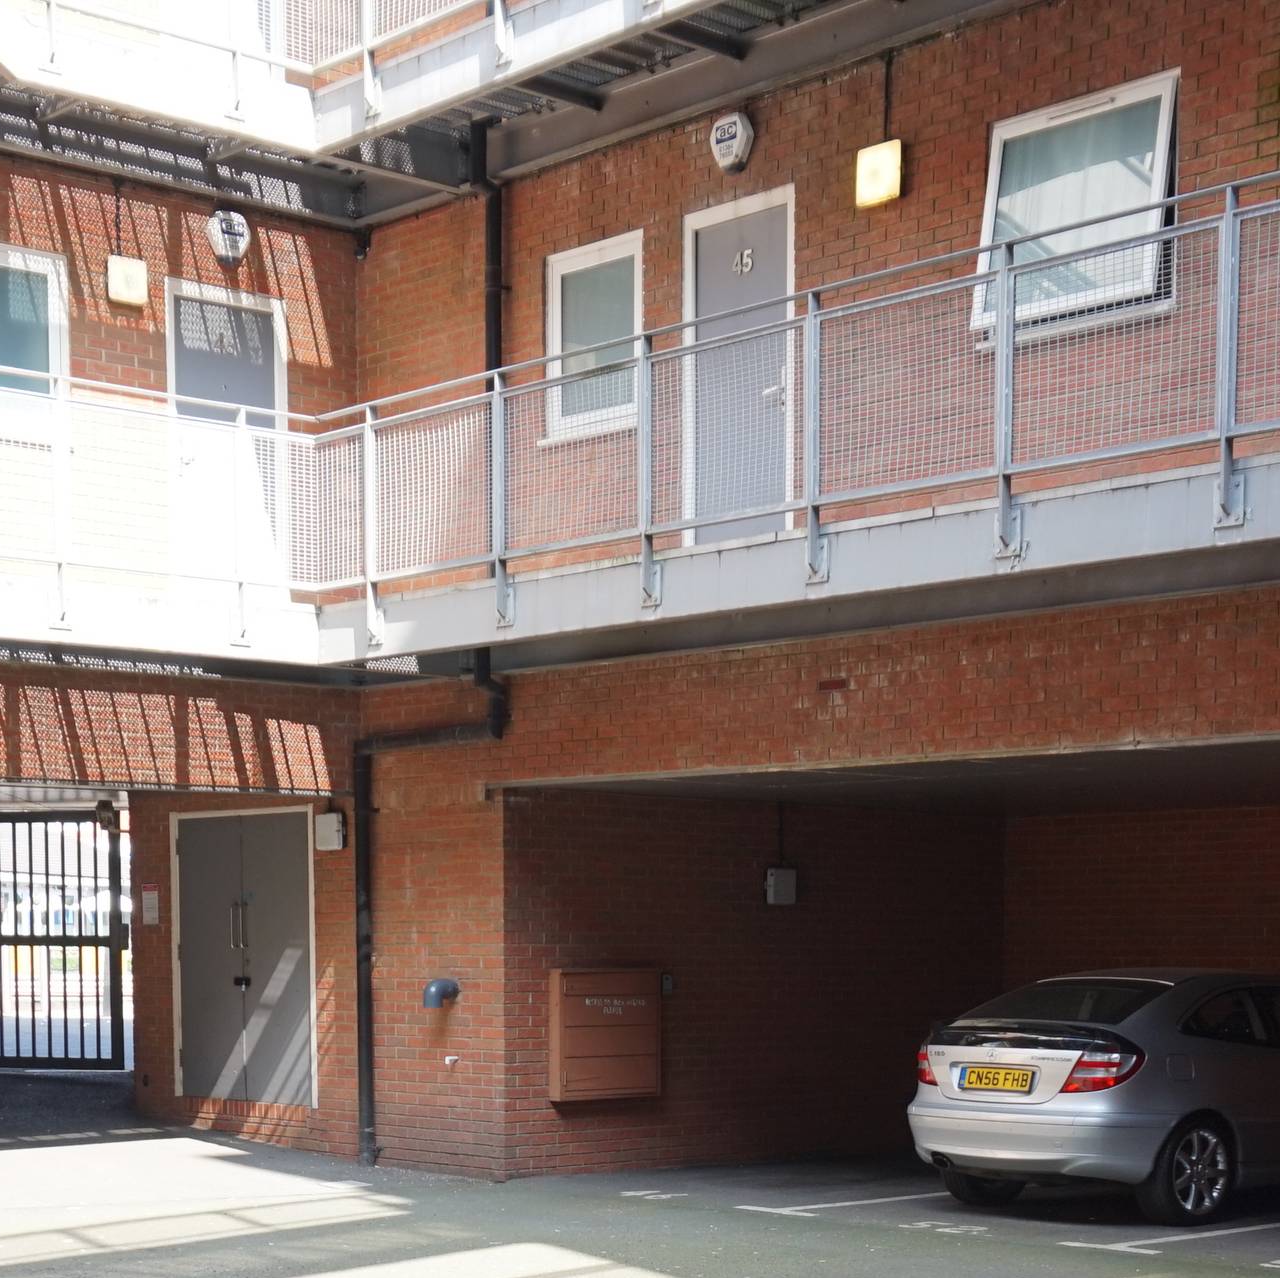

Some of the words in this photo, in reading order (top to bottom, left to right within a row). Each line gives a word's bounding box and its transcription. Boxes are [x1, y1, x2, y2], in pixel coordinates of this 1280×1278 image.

[730, 248, 753, 276] 45
[967, 1070, 1000, 1086] CN56
[1003, 1072, 1030, 1088] FHB
